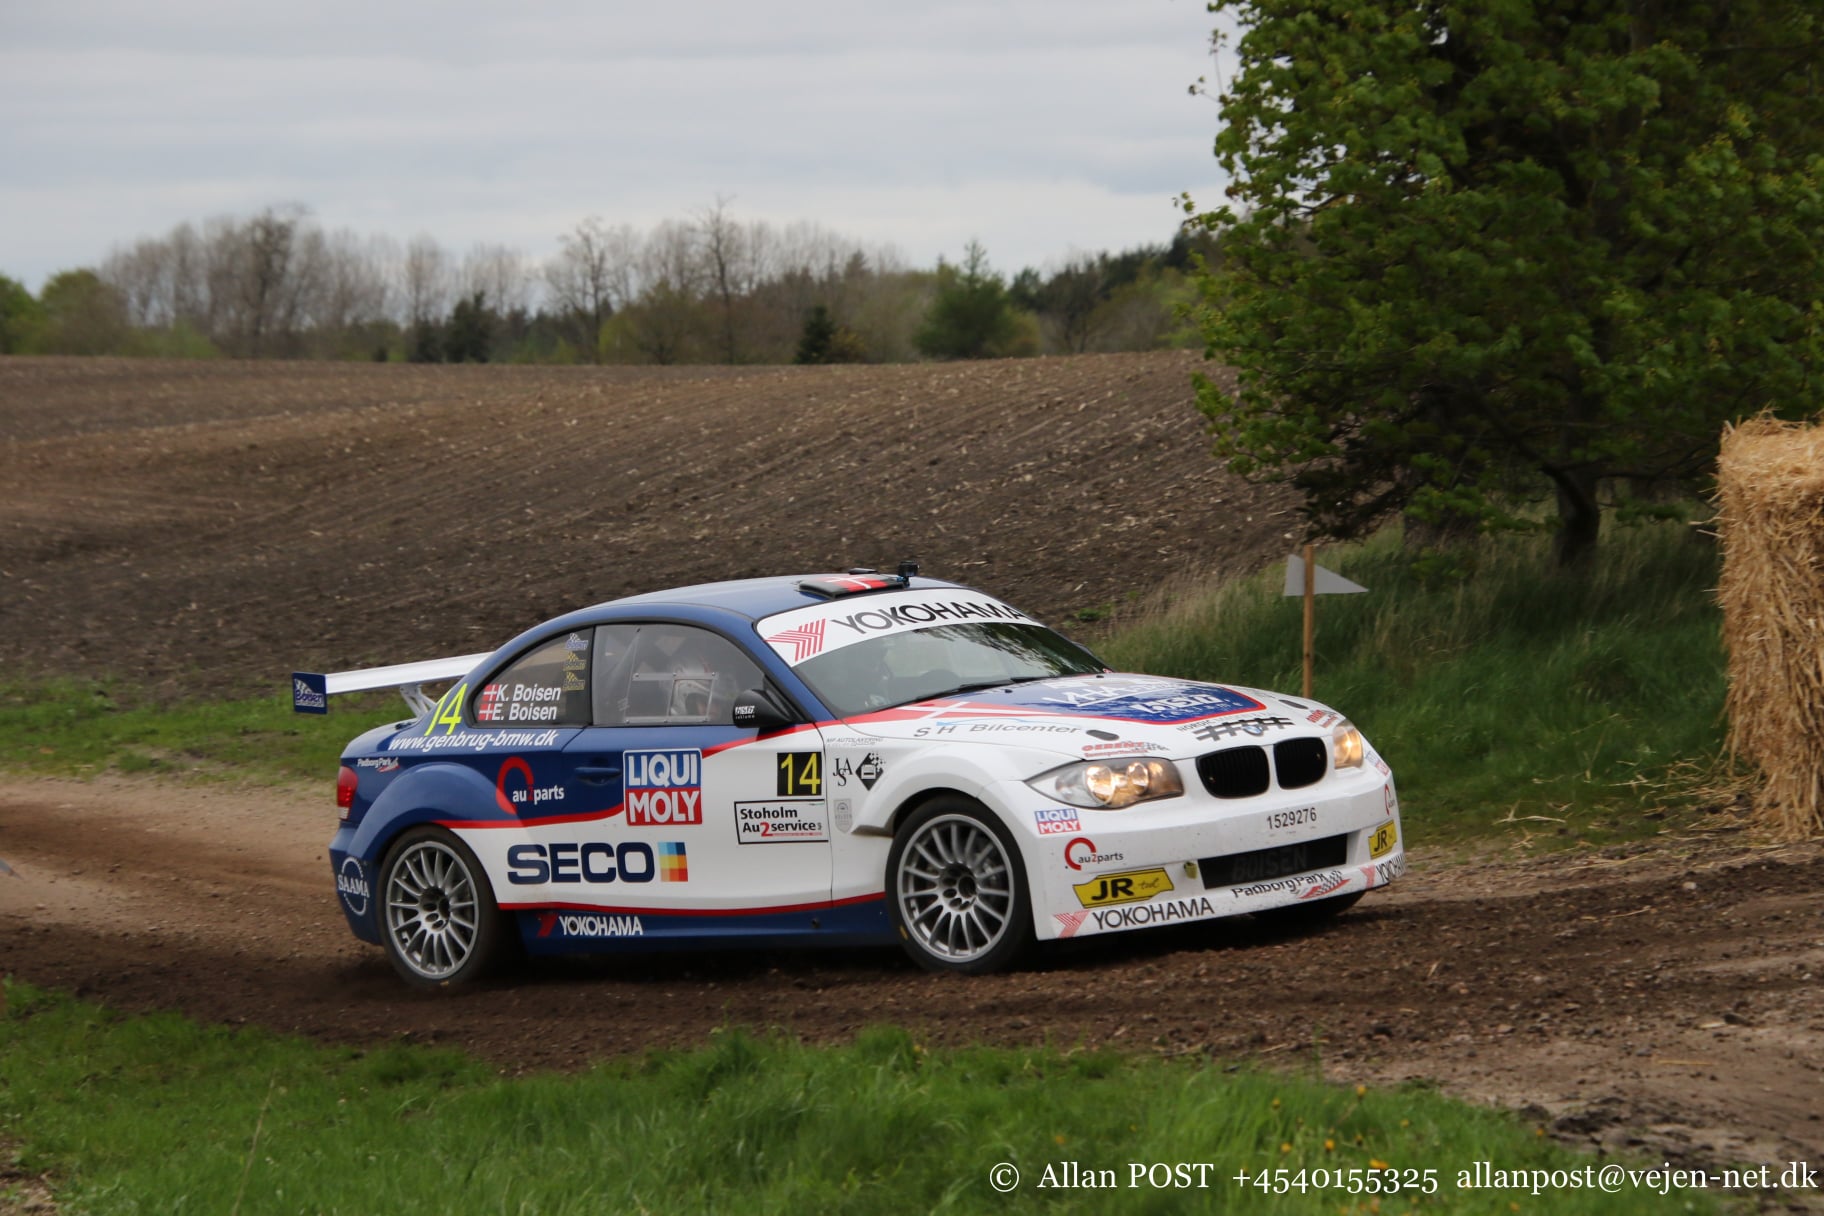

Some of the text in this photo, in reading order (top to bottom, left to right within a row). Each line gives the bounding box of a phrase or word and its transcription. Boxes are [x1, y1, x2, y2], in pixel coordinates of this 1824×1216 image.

[831, 601, 1027, 634] YOKOHAMA
[496, 683, 510, 702] K.
[512, 683, 562, 701] Boisen
[424, 683, 468, 736] 14
[492, 702, 558, 720] E. Boisen
[914, 723, 1081, 738] S H Bilcenter
[388, 731, 558, 752] www.genbrug-bmw.dk
[630, 754, 698, 787] LIQUI
[781, 753, 821, 795] 14
[512, 785, 564, 805] au2parts
[630, 790, 699, 824] MOLY
[740, 806, 798, 820] Stoholm
[1037, 810, 1077, 823] LIQUI
[742, 819, 816, 837] Au2service
[1039, 820, 1080, 833] MOLY
[1267, 807, 1317, 829] 1529276
[1371, 829, 1388, 852] JR
[507, 842, 655, 884] SECO
[1078, 851, 1124, 865] au2parts
[338, 873, 370, 898] SAAMA
[1091, 877, 1135, 900] JR
[1093, 897, 1214, 930] YOKOHAMA
[560, 915, 643, 936] YOKOHAMA
